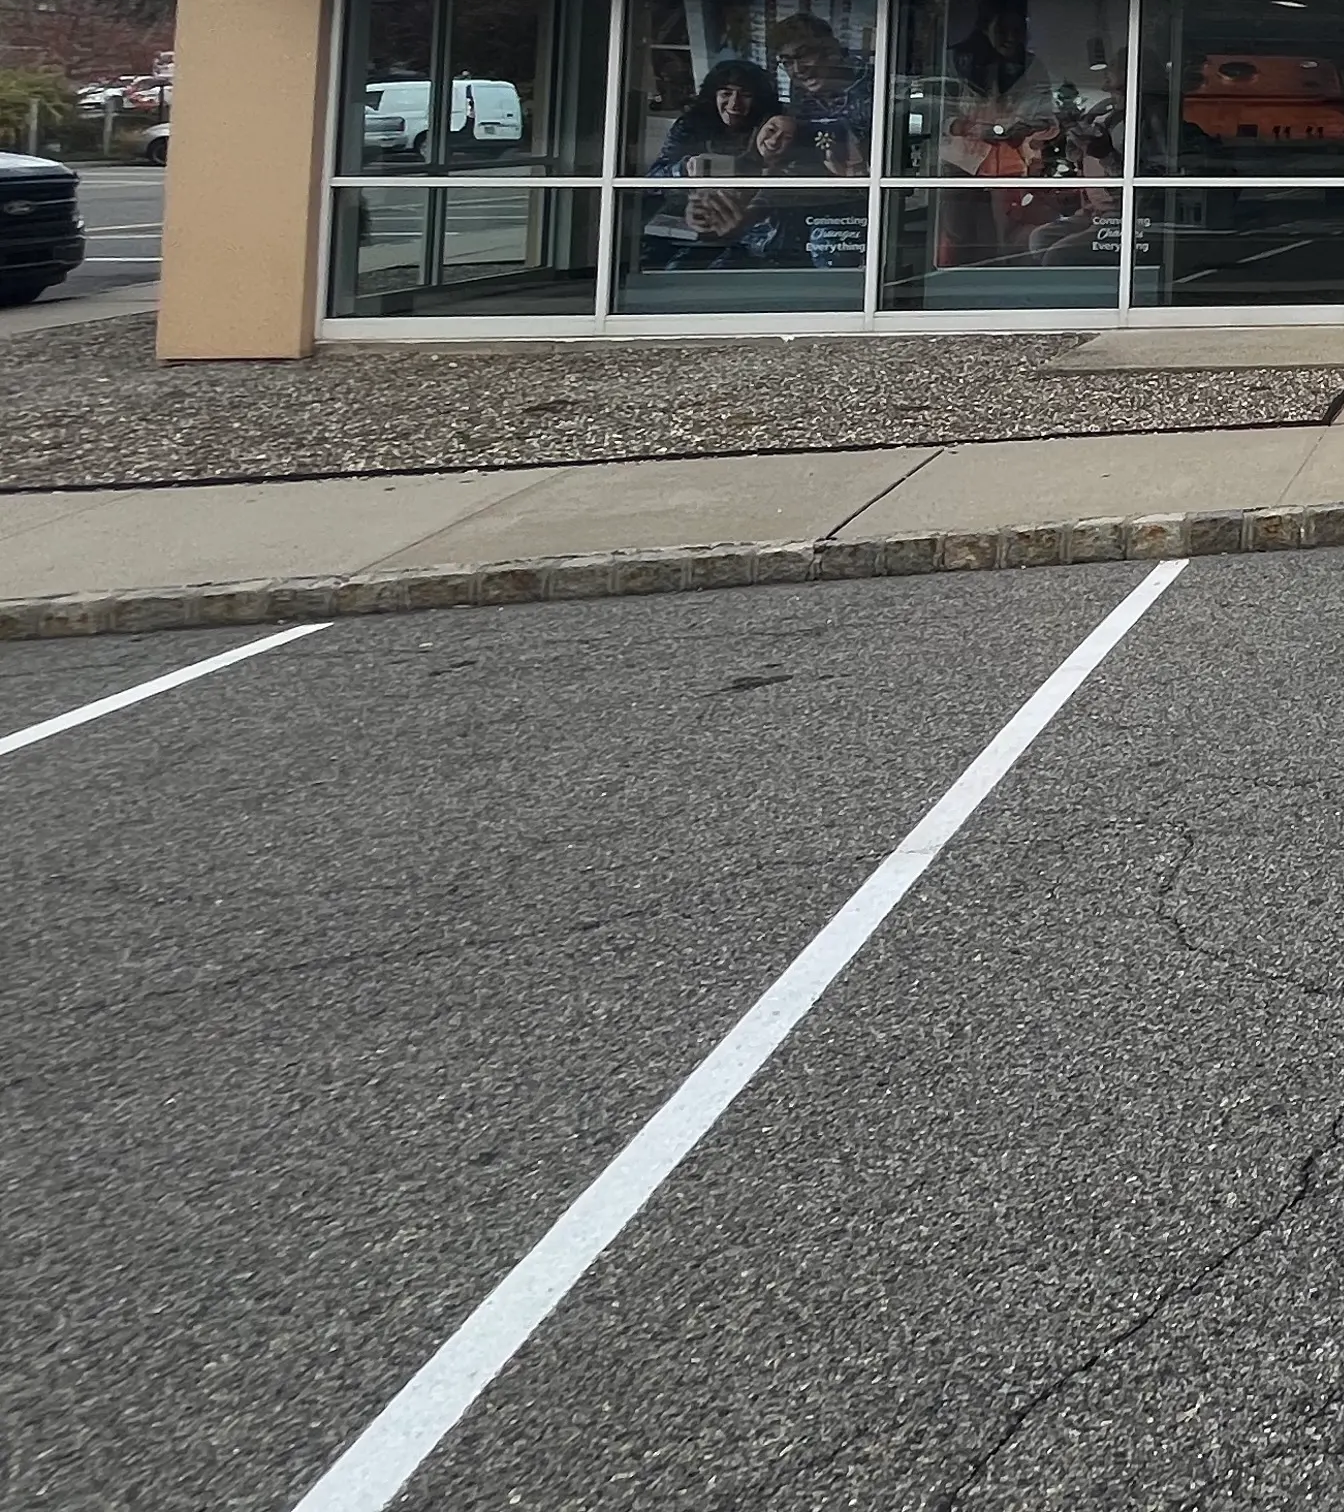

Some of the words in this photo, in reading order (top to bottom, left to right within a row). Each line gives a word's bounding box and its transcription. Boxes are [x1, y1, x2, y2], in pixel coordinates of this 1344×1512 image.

[805, 216, 868, 227] Connecting
[1092, 216, 1151, 227] Connng
[810, 228, 861, 241] Changes
[806, 242, 866, 253] Everything
[1092, 241, 1149, 253] Everyng
